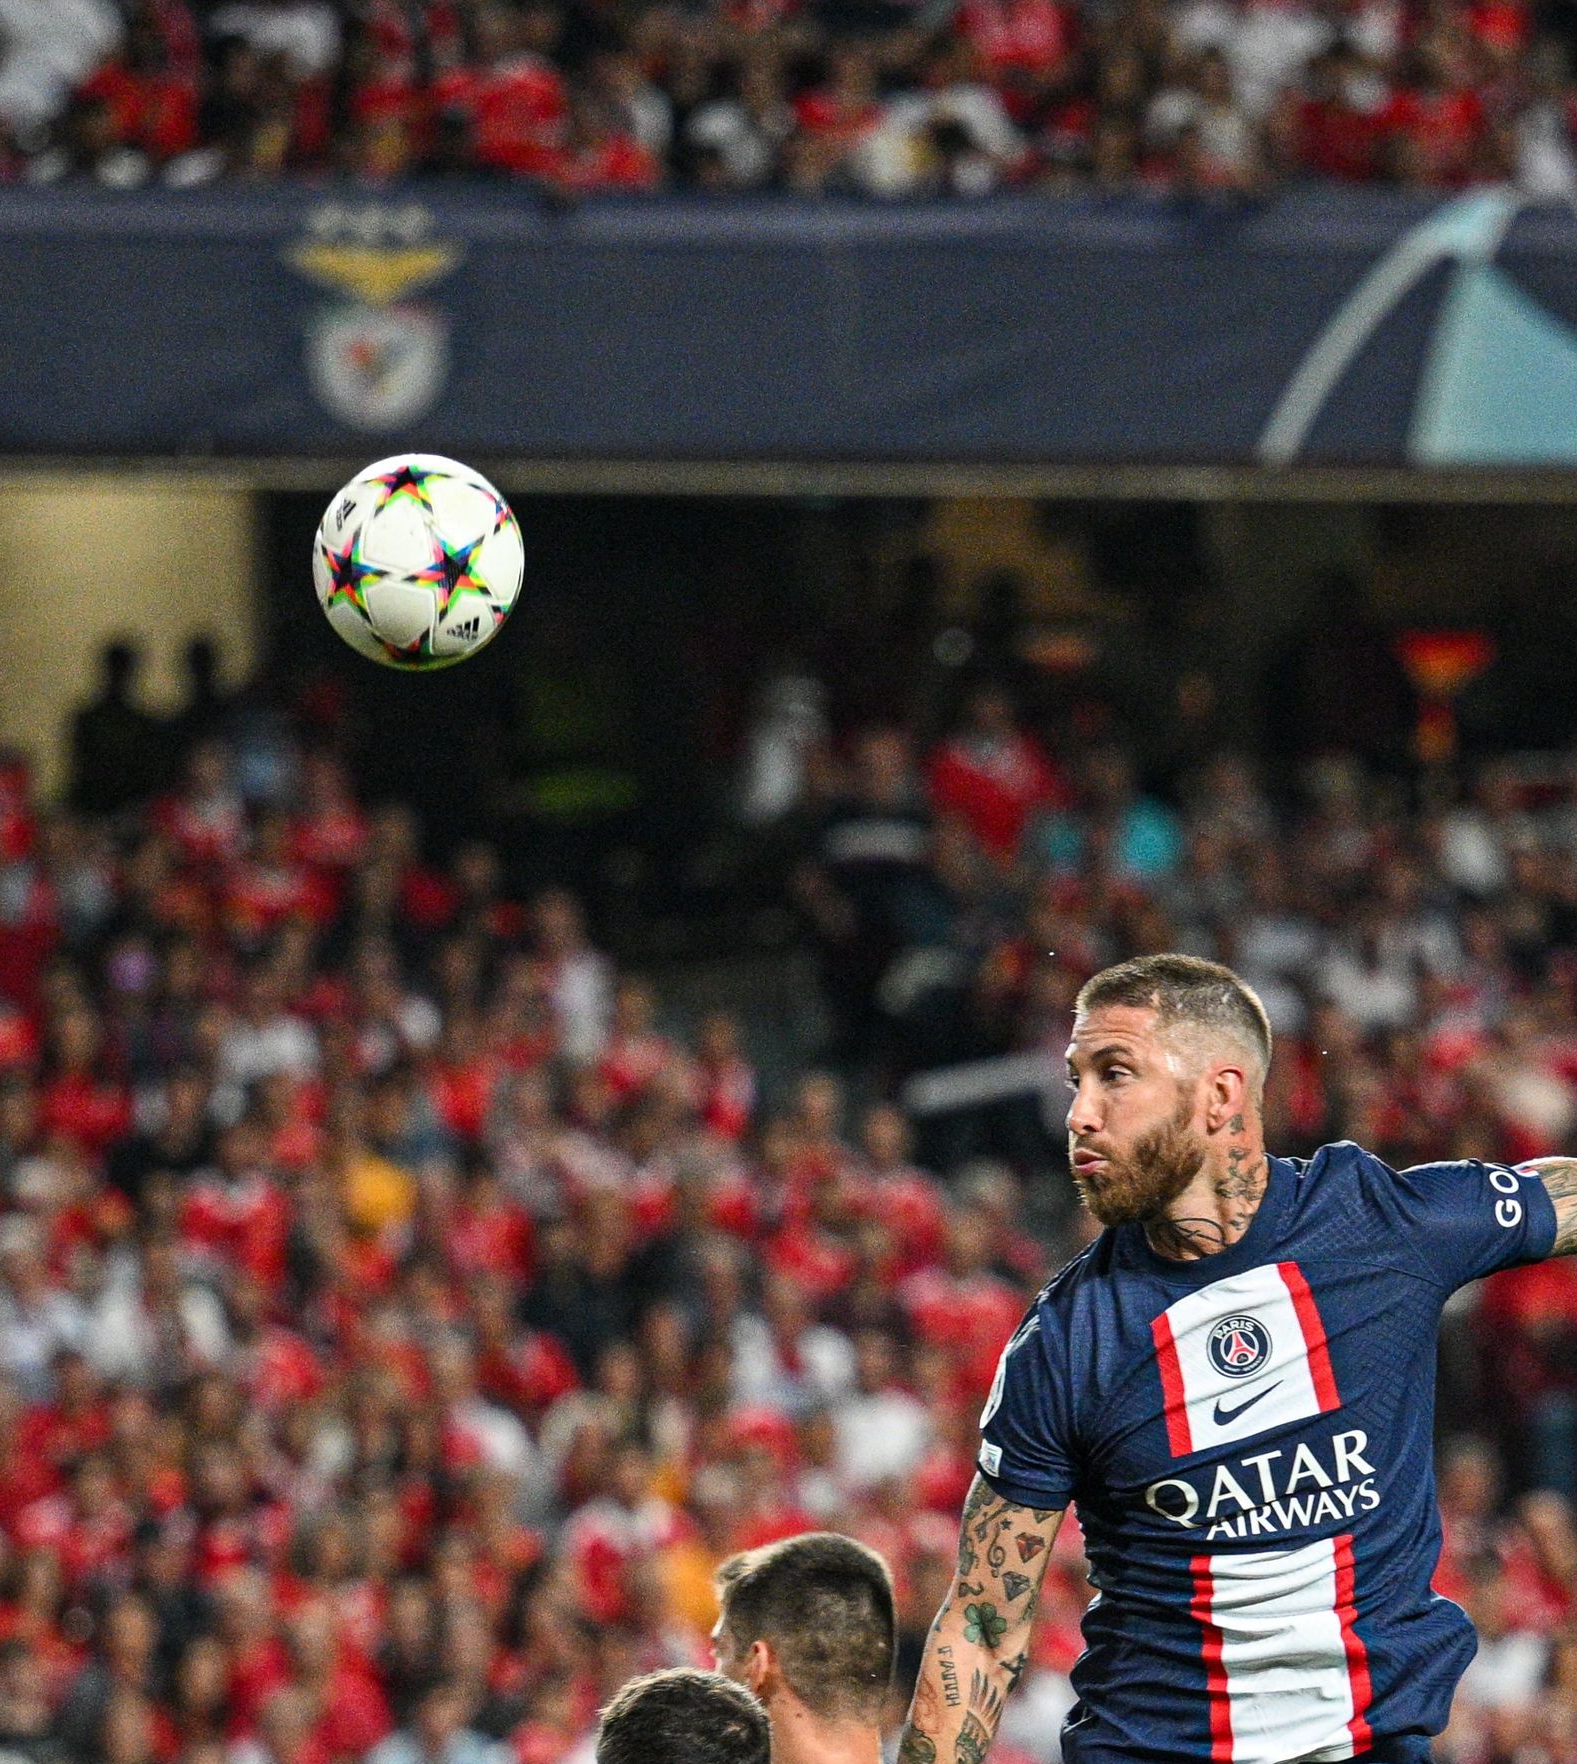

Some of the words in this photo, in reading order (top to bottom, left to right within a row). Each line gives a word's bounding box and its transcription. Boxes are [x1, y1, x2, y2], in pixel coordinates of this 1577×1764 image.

[1489, 1171, 1522, 1228] GO
[1213, 1320, 1255, 1340] PARIS
[1145, 1429, 1376, 1529] QATAR
[1205, 1478, 1381, 1541] AIRWAYS
